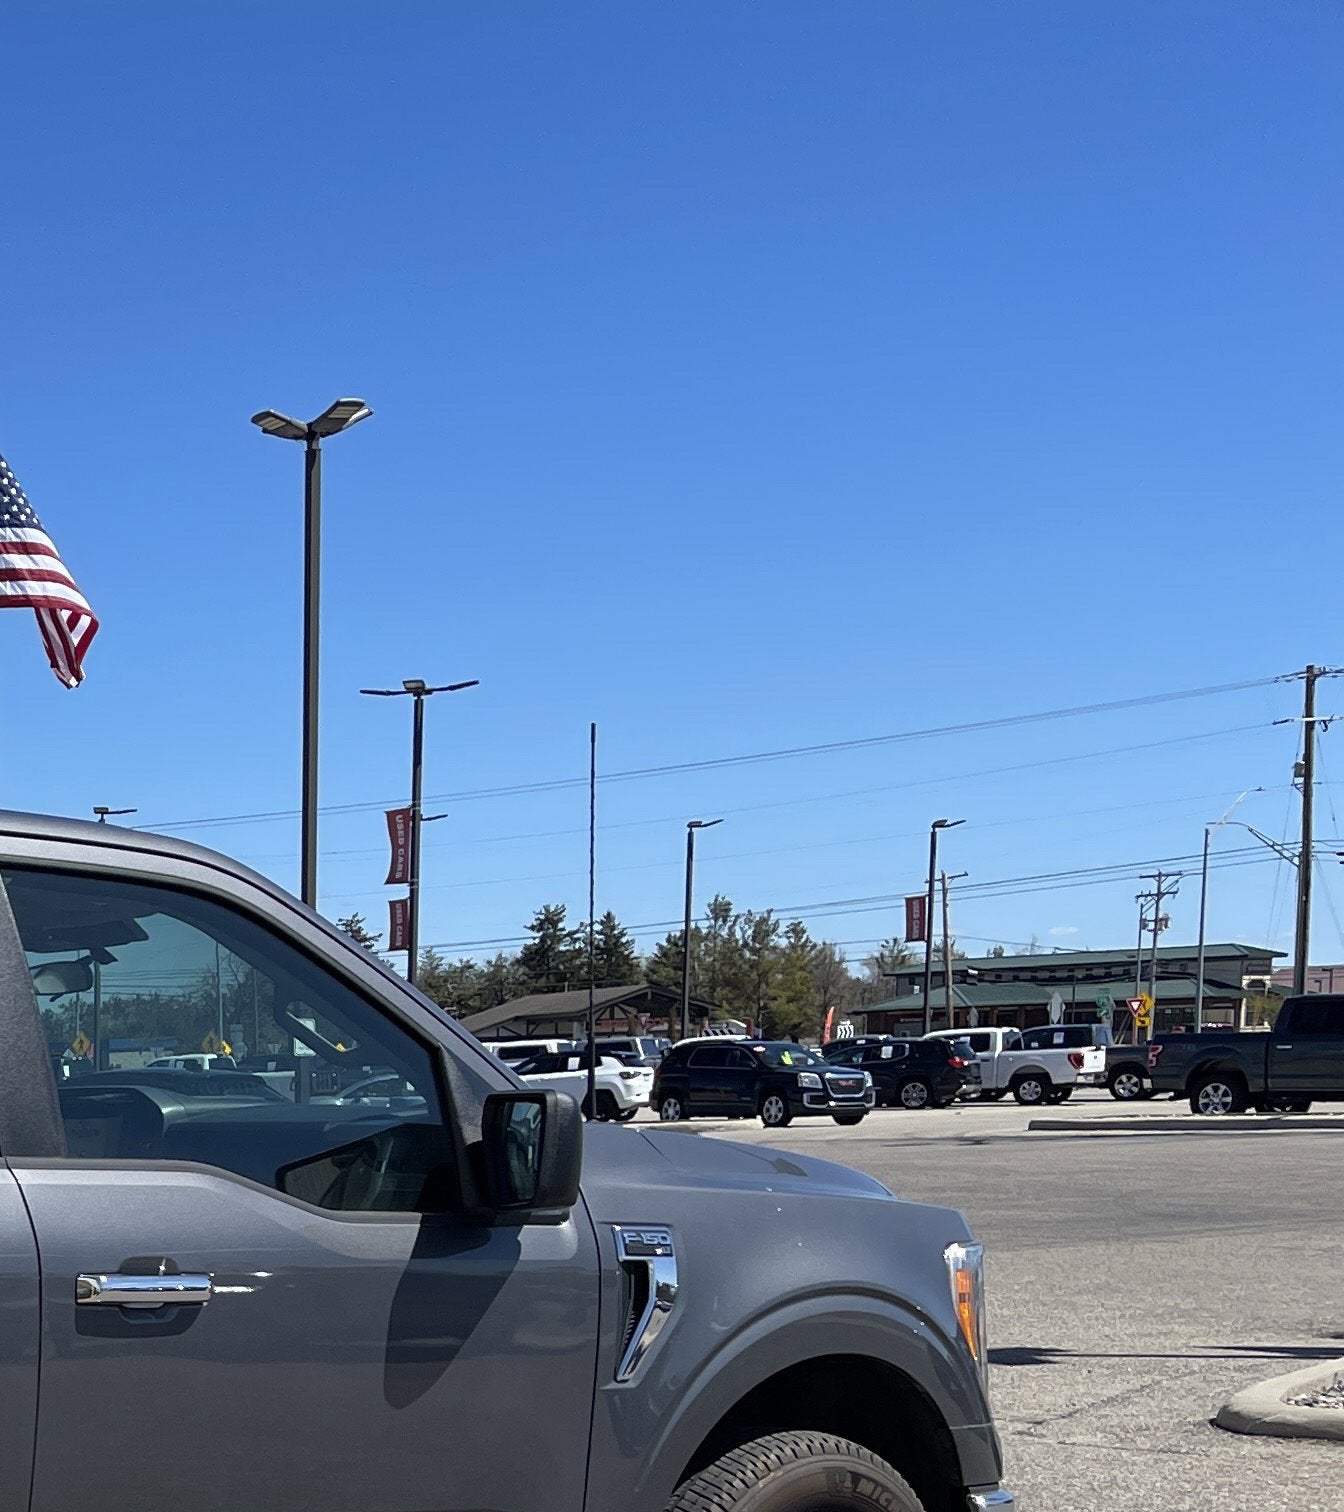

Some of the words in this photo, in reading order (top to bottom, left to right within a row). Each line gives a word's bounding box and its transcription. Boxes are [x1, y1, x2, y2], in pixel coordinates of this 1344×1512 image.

[395, 814, 405, 845] USED
[395, 849, 405, 879] CARS
[395, 903, 403, 924] USED
[395, 925, 403, 946] CARS
